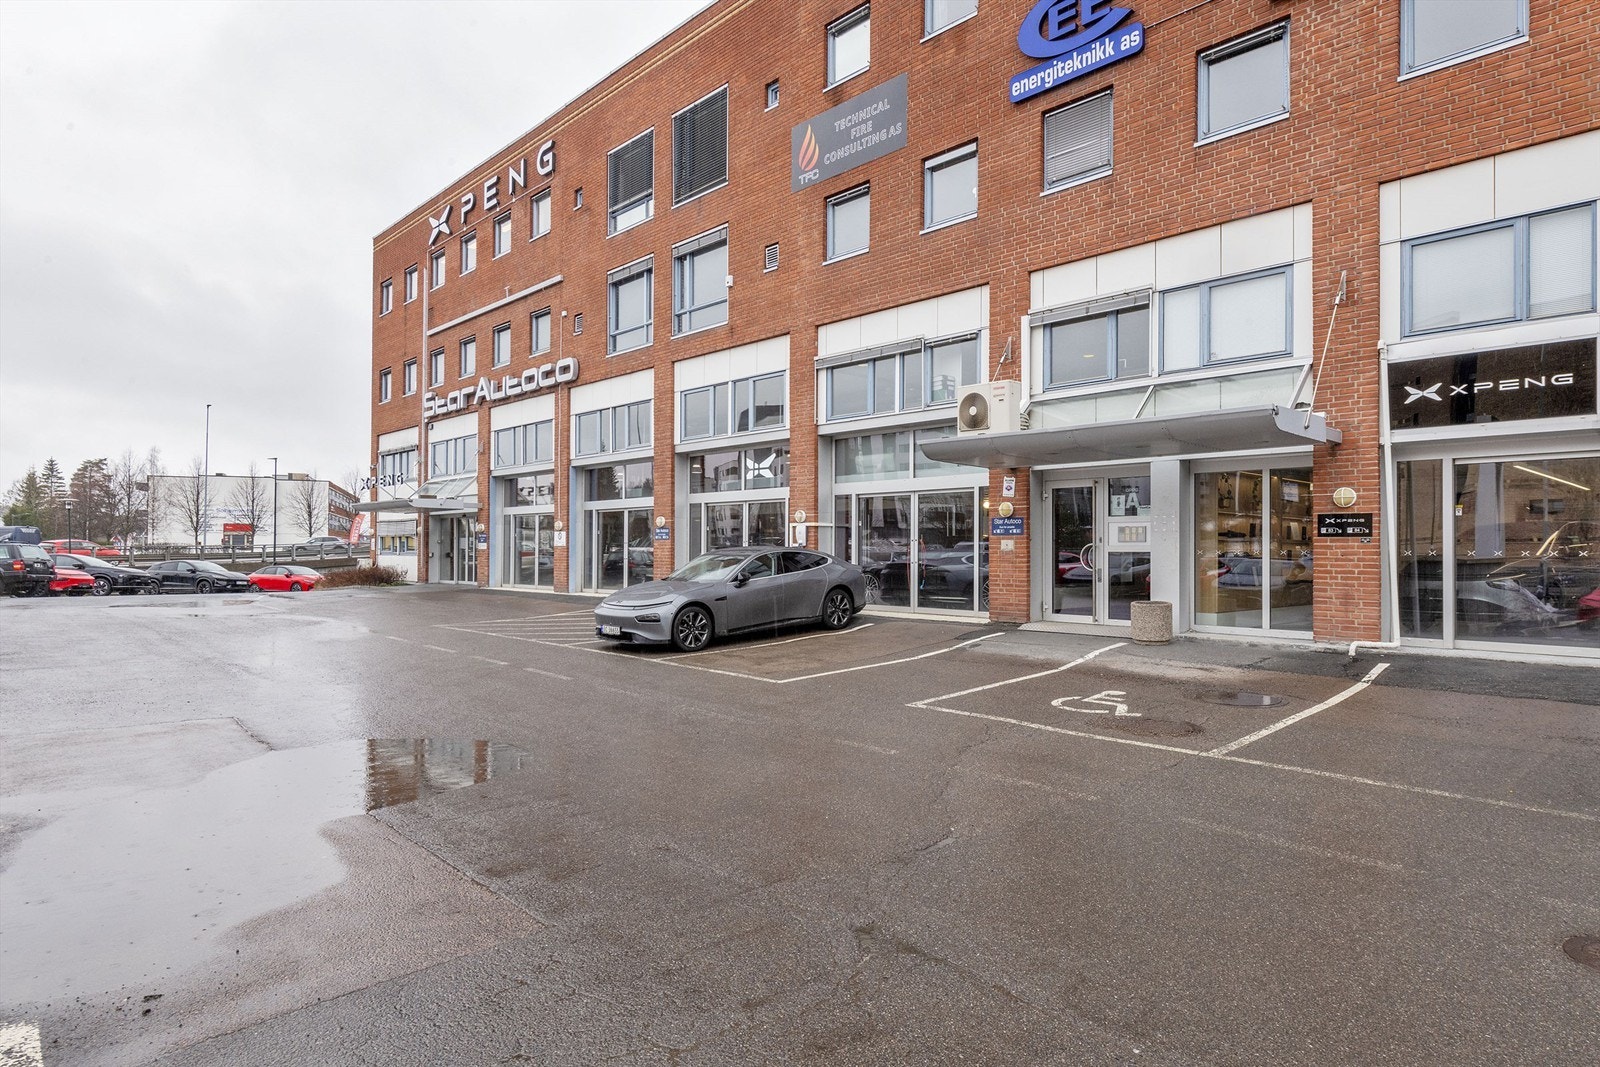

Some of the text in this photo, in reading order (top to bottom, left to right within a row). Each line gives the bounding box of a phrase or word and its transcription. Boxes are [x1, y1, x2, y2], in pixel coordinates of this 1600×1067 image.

[1011, 30, 1140, 96] energiteknikk as
[834, 98, 890, 132] TECHNICAL
[823, 122, 903, 165] CONSULTING AS
[850, 120, 873, 140] FIRE
[799, 168, 819, 185] TFC
[1449, 372, 1574, 397] XPENG
